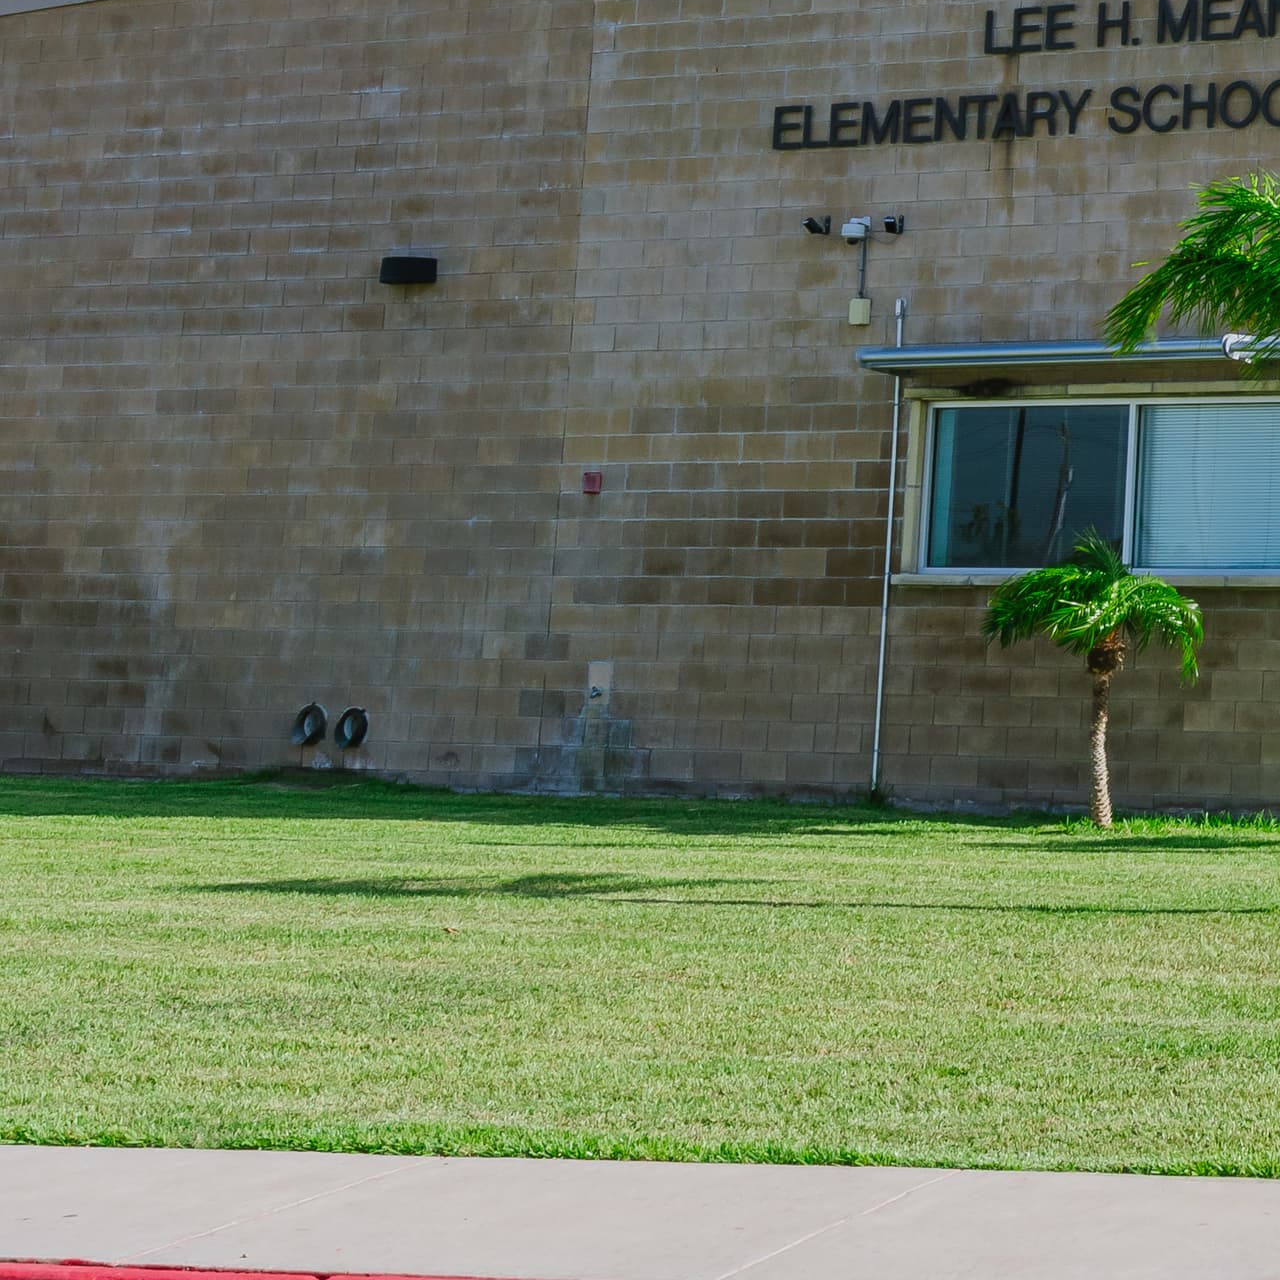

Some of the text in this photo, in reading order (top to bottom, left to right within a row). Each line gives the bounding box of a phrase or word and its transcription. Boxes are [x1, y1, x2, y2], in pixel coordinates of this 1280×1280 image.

[984, 3, 1076, 55] LEE
[1096, 0, 1139, 48] H.
[772, 88, 1092, 151] ELEMENTARY
